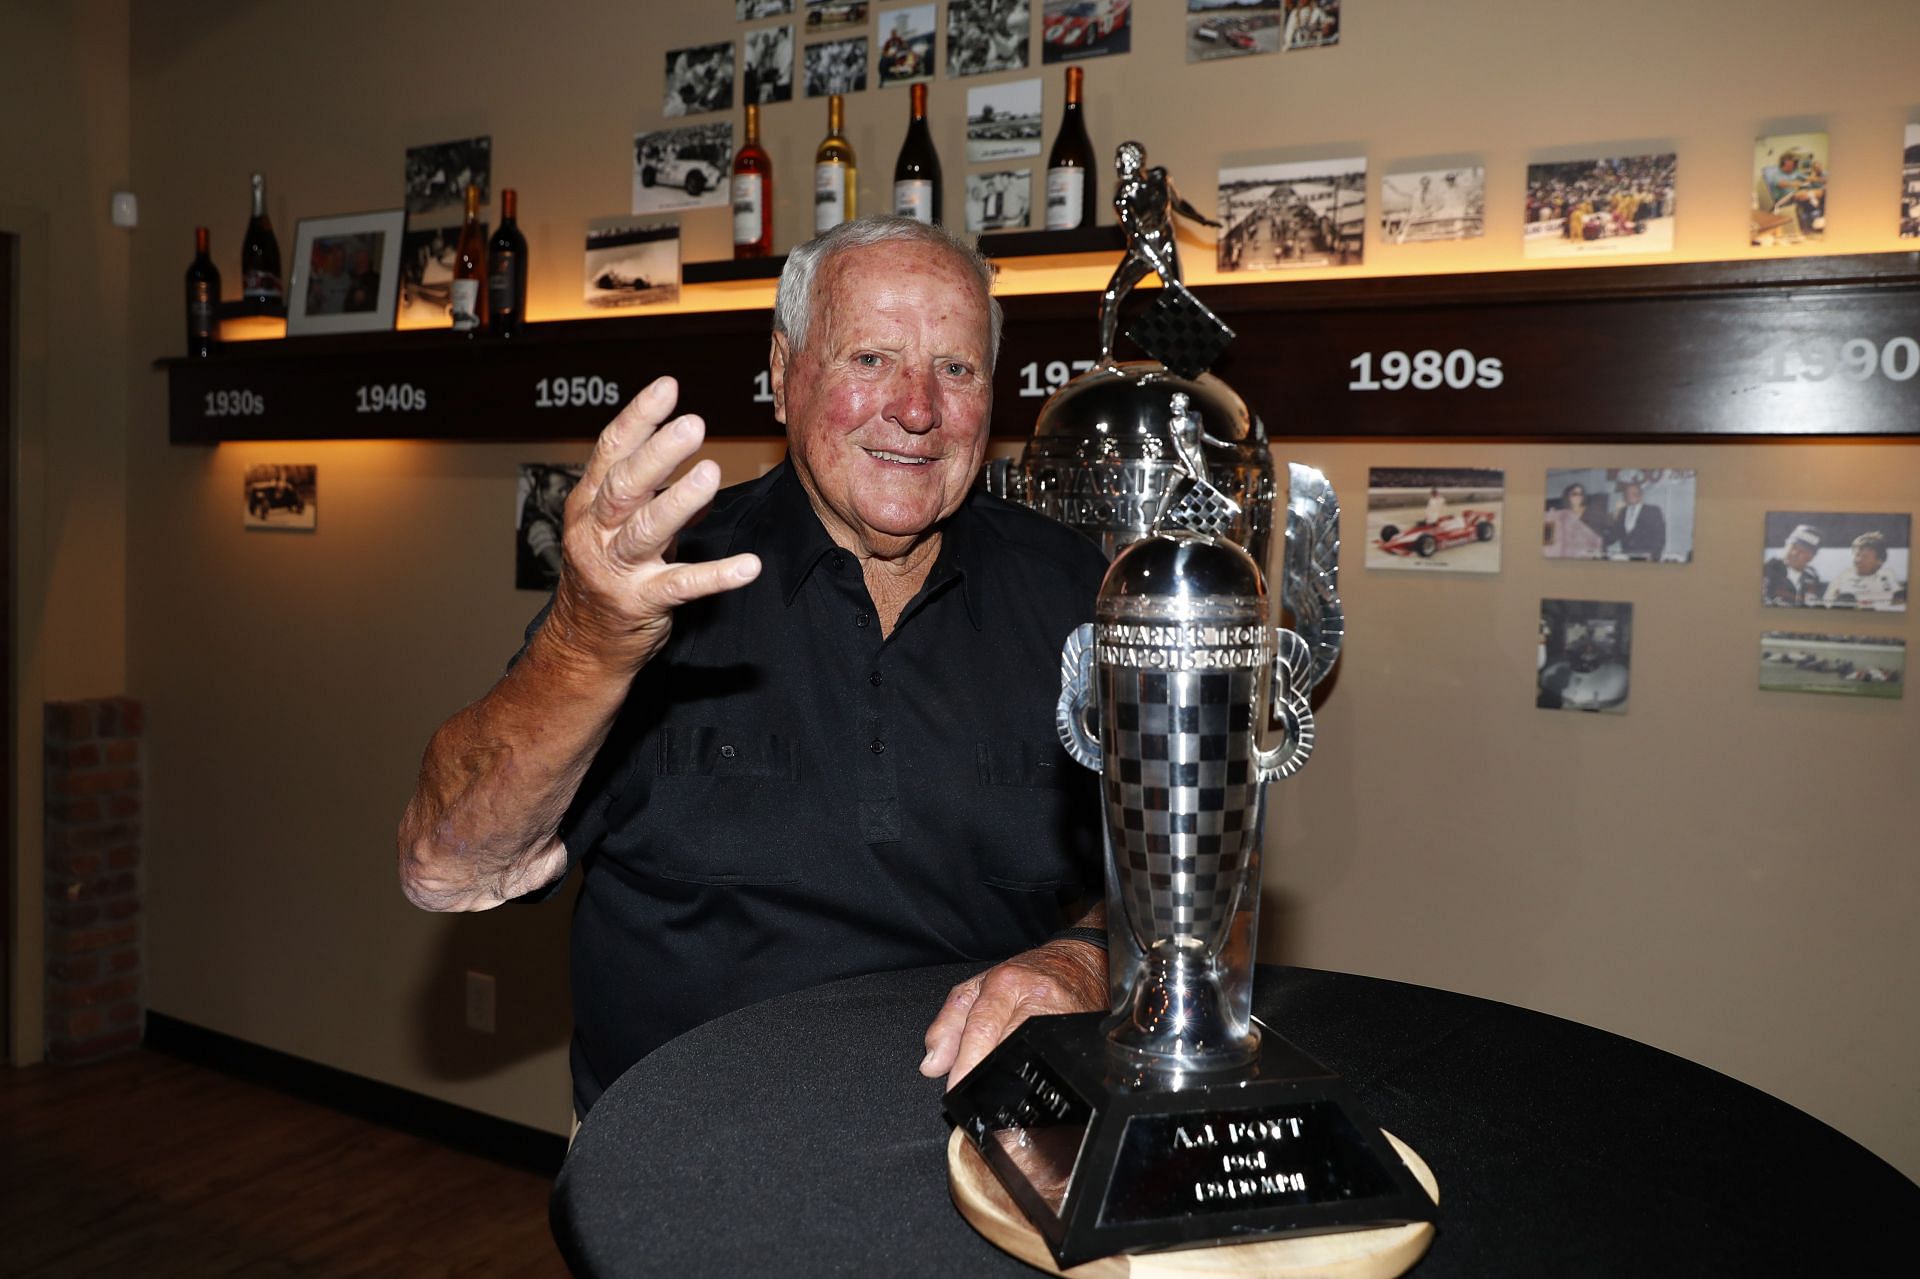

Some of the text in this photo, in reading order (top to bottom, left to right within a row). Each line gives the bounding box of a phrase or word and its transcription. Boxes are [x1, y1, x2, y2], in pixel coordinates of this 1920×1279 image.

[1349, 349, 1504, 390] 1980s
[205, 390, 264, 416] 1930s
[356, 383, 427, 413] 1940s
[535, 376, 620, 407] 1950s
[1204, 648, 1243, 669] 500
[1229, 1117, 1303, 1144] FOYT
[1260, 1172, 1306, 1195] MPH
